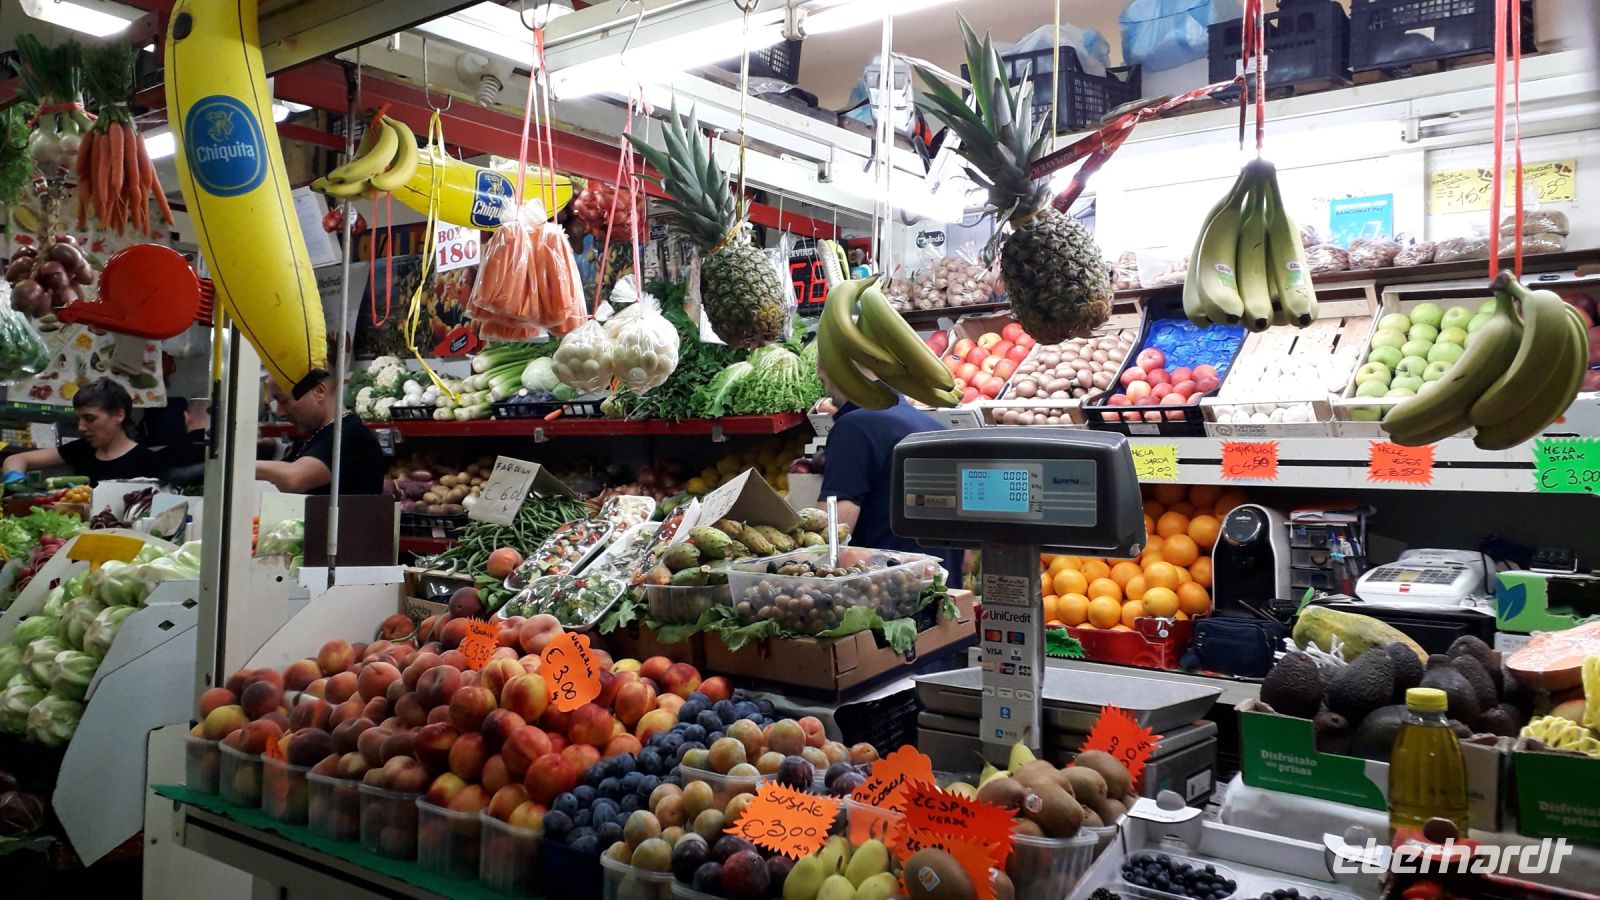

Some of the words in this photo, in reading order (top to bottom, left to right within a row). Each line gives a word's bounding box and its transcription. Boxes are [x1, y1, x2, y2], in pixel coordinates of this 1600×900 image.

[196, 141, 256, 163] Chiquita
[473, 199, 500, 221] Chiqu
[438, 239, 478, 267] 180
[789, 249, 816, 258] ERVING
[1549, 453, 1585, 462] STARK
[990, 610, 1031, 623] UniCredit
[986, 647, 1003, 656] VISA
[765, 791, 824, 817] SUSINE
